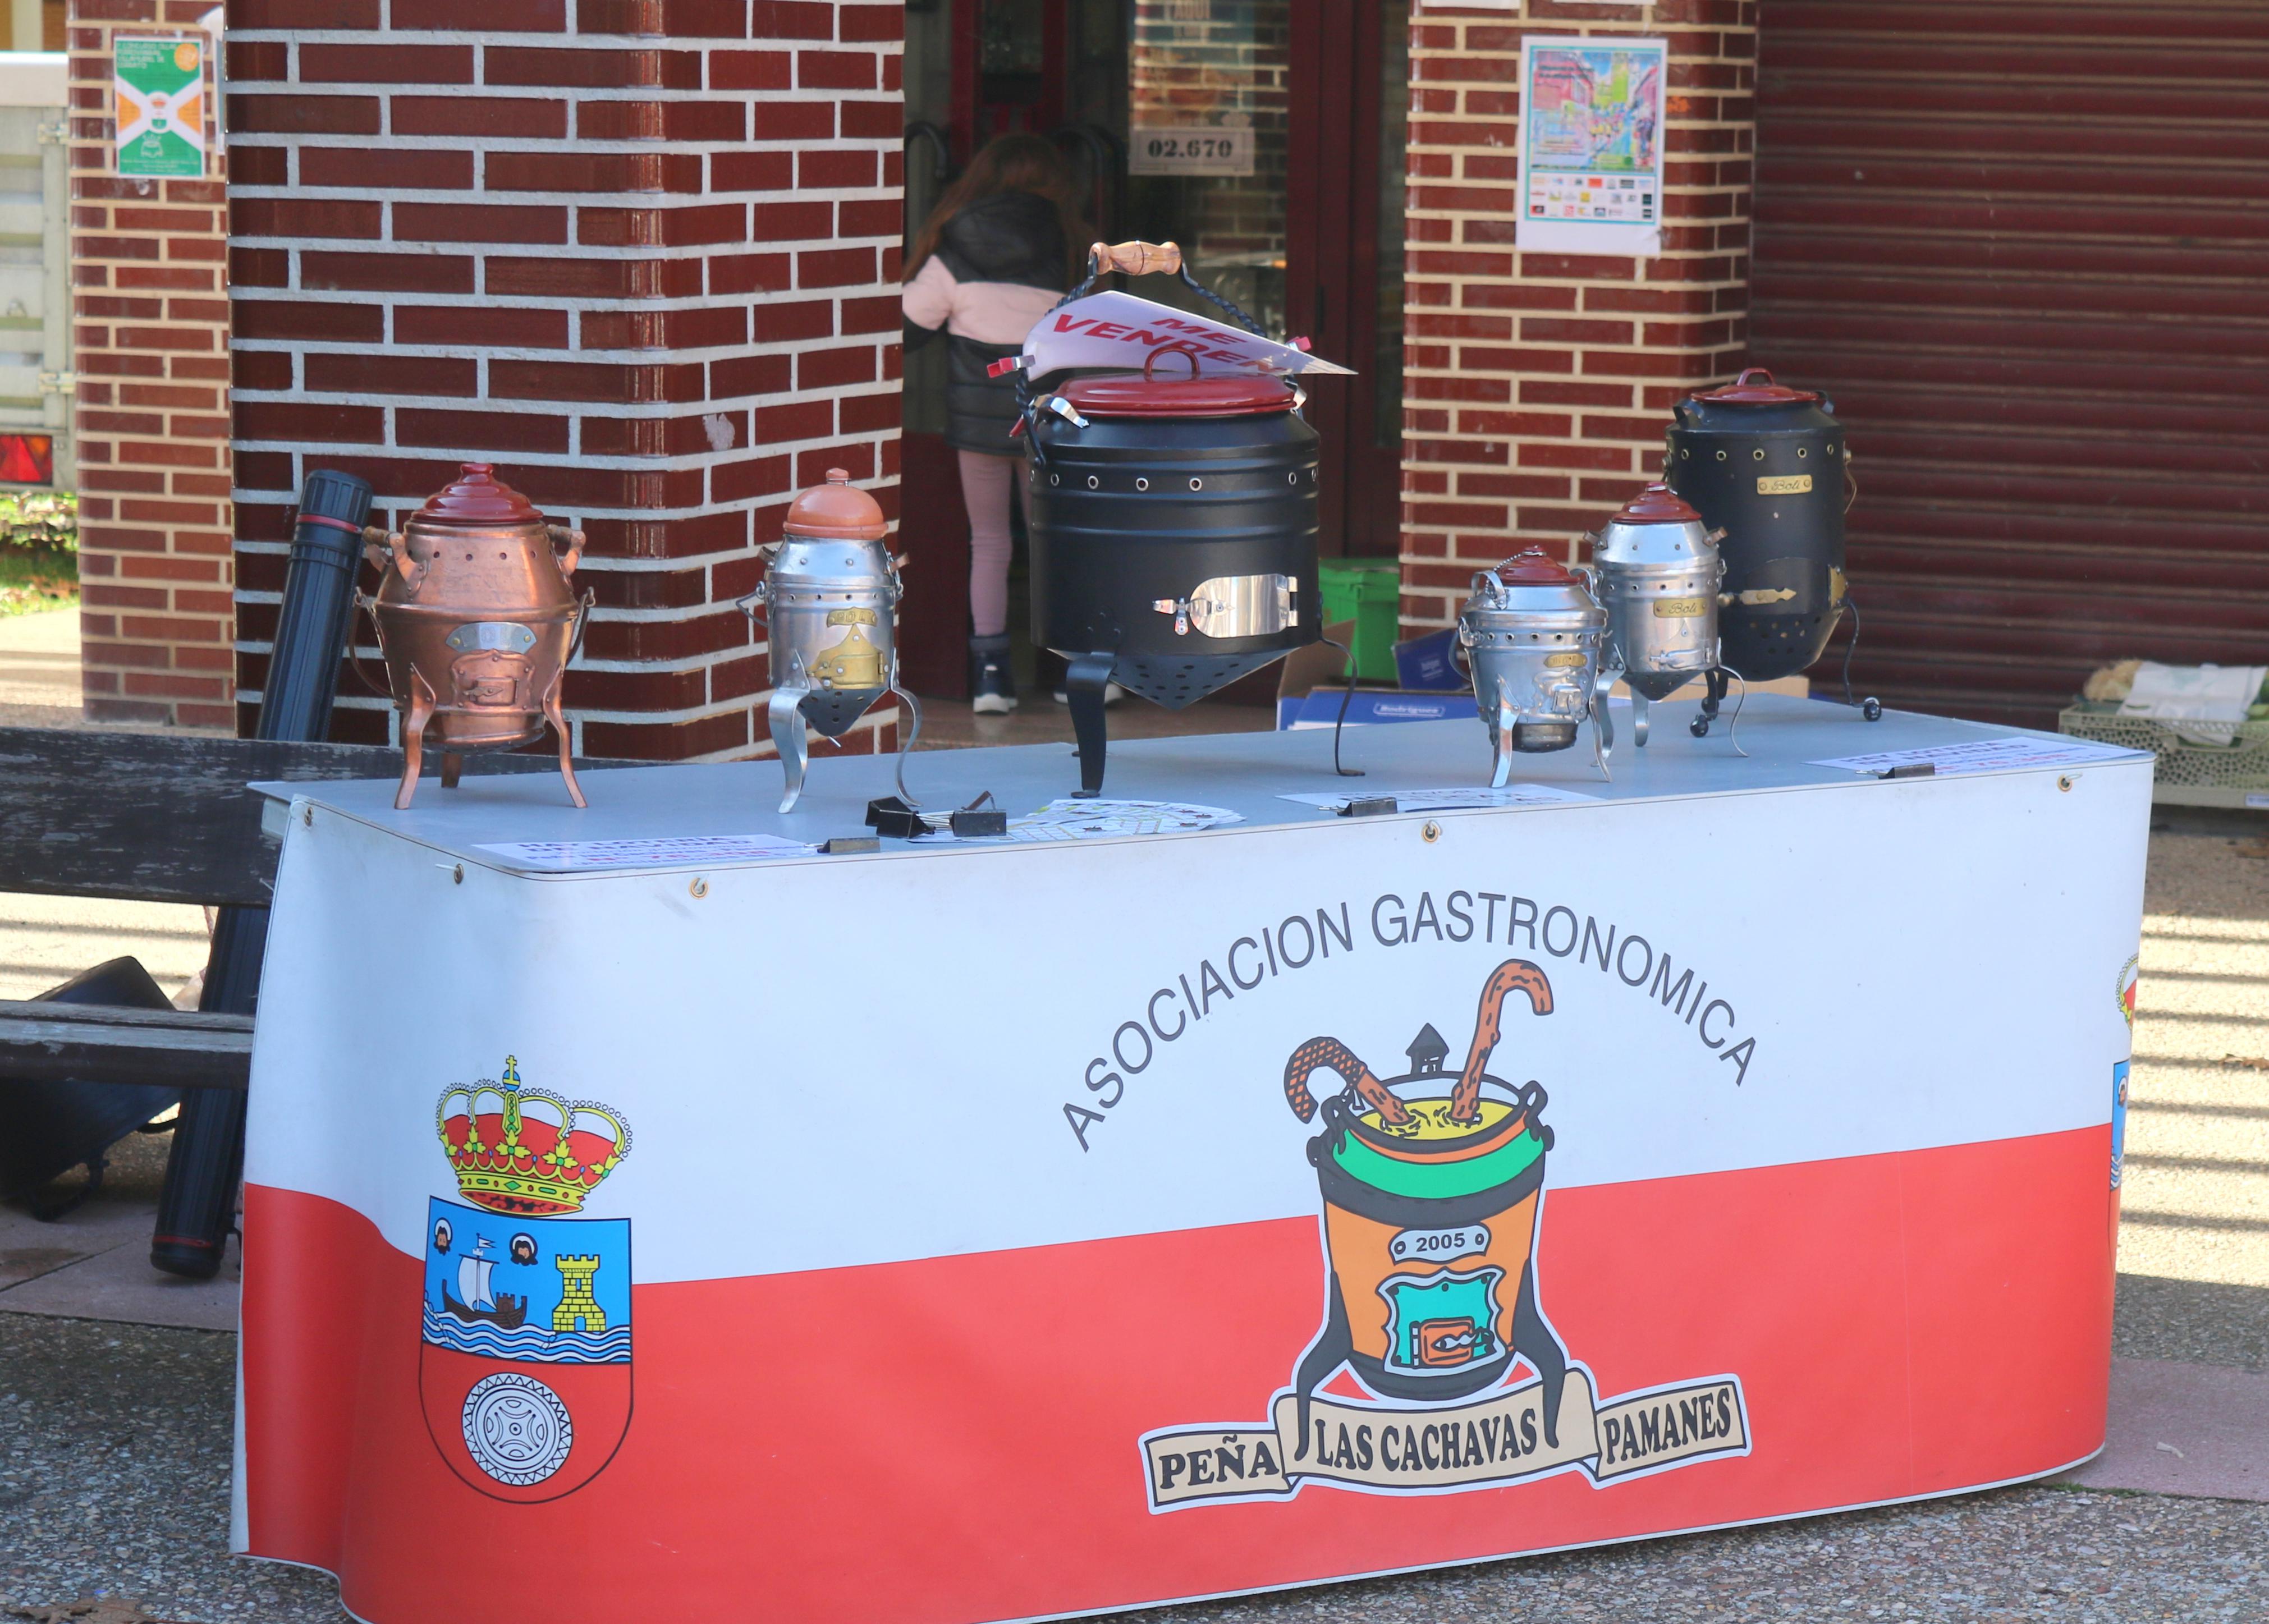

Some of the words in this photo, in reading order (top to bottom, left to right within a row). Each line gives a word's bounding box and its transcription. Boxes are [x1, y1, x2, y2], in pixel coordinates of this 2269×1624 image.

[1148, 139, 1232, 158] 02.670
[1150, 318, 1250, 345] ME
[1062, 901, 1354, 1152] ASOCIACION
[1371, 890, 1757, 1086] GASTRONOMICA
[1416, 1232, 1466, 1252] 2005
[1158, 1435, 1283, 1490] PEÑA
[1315, 1419, 1374, 1470] LAS
[1380, 1407, 1539, 1472] CACHAVAS
[1604, 1387, 1731, 1459] PAMANES
